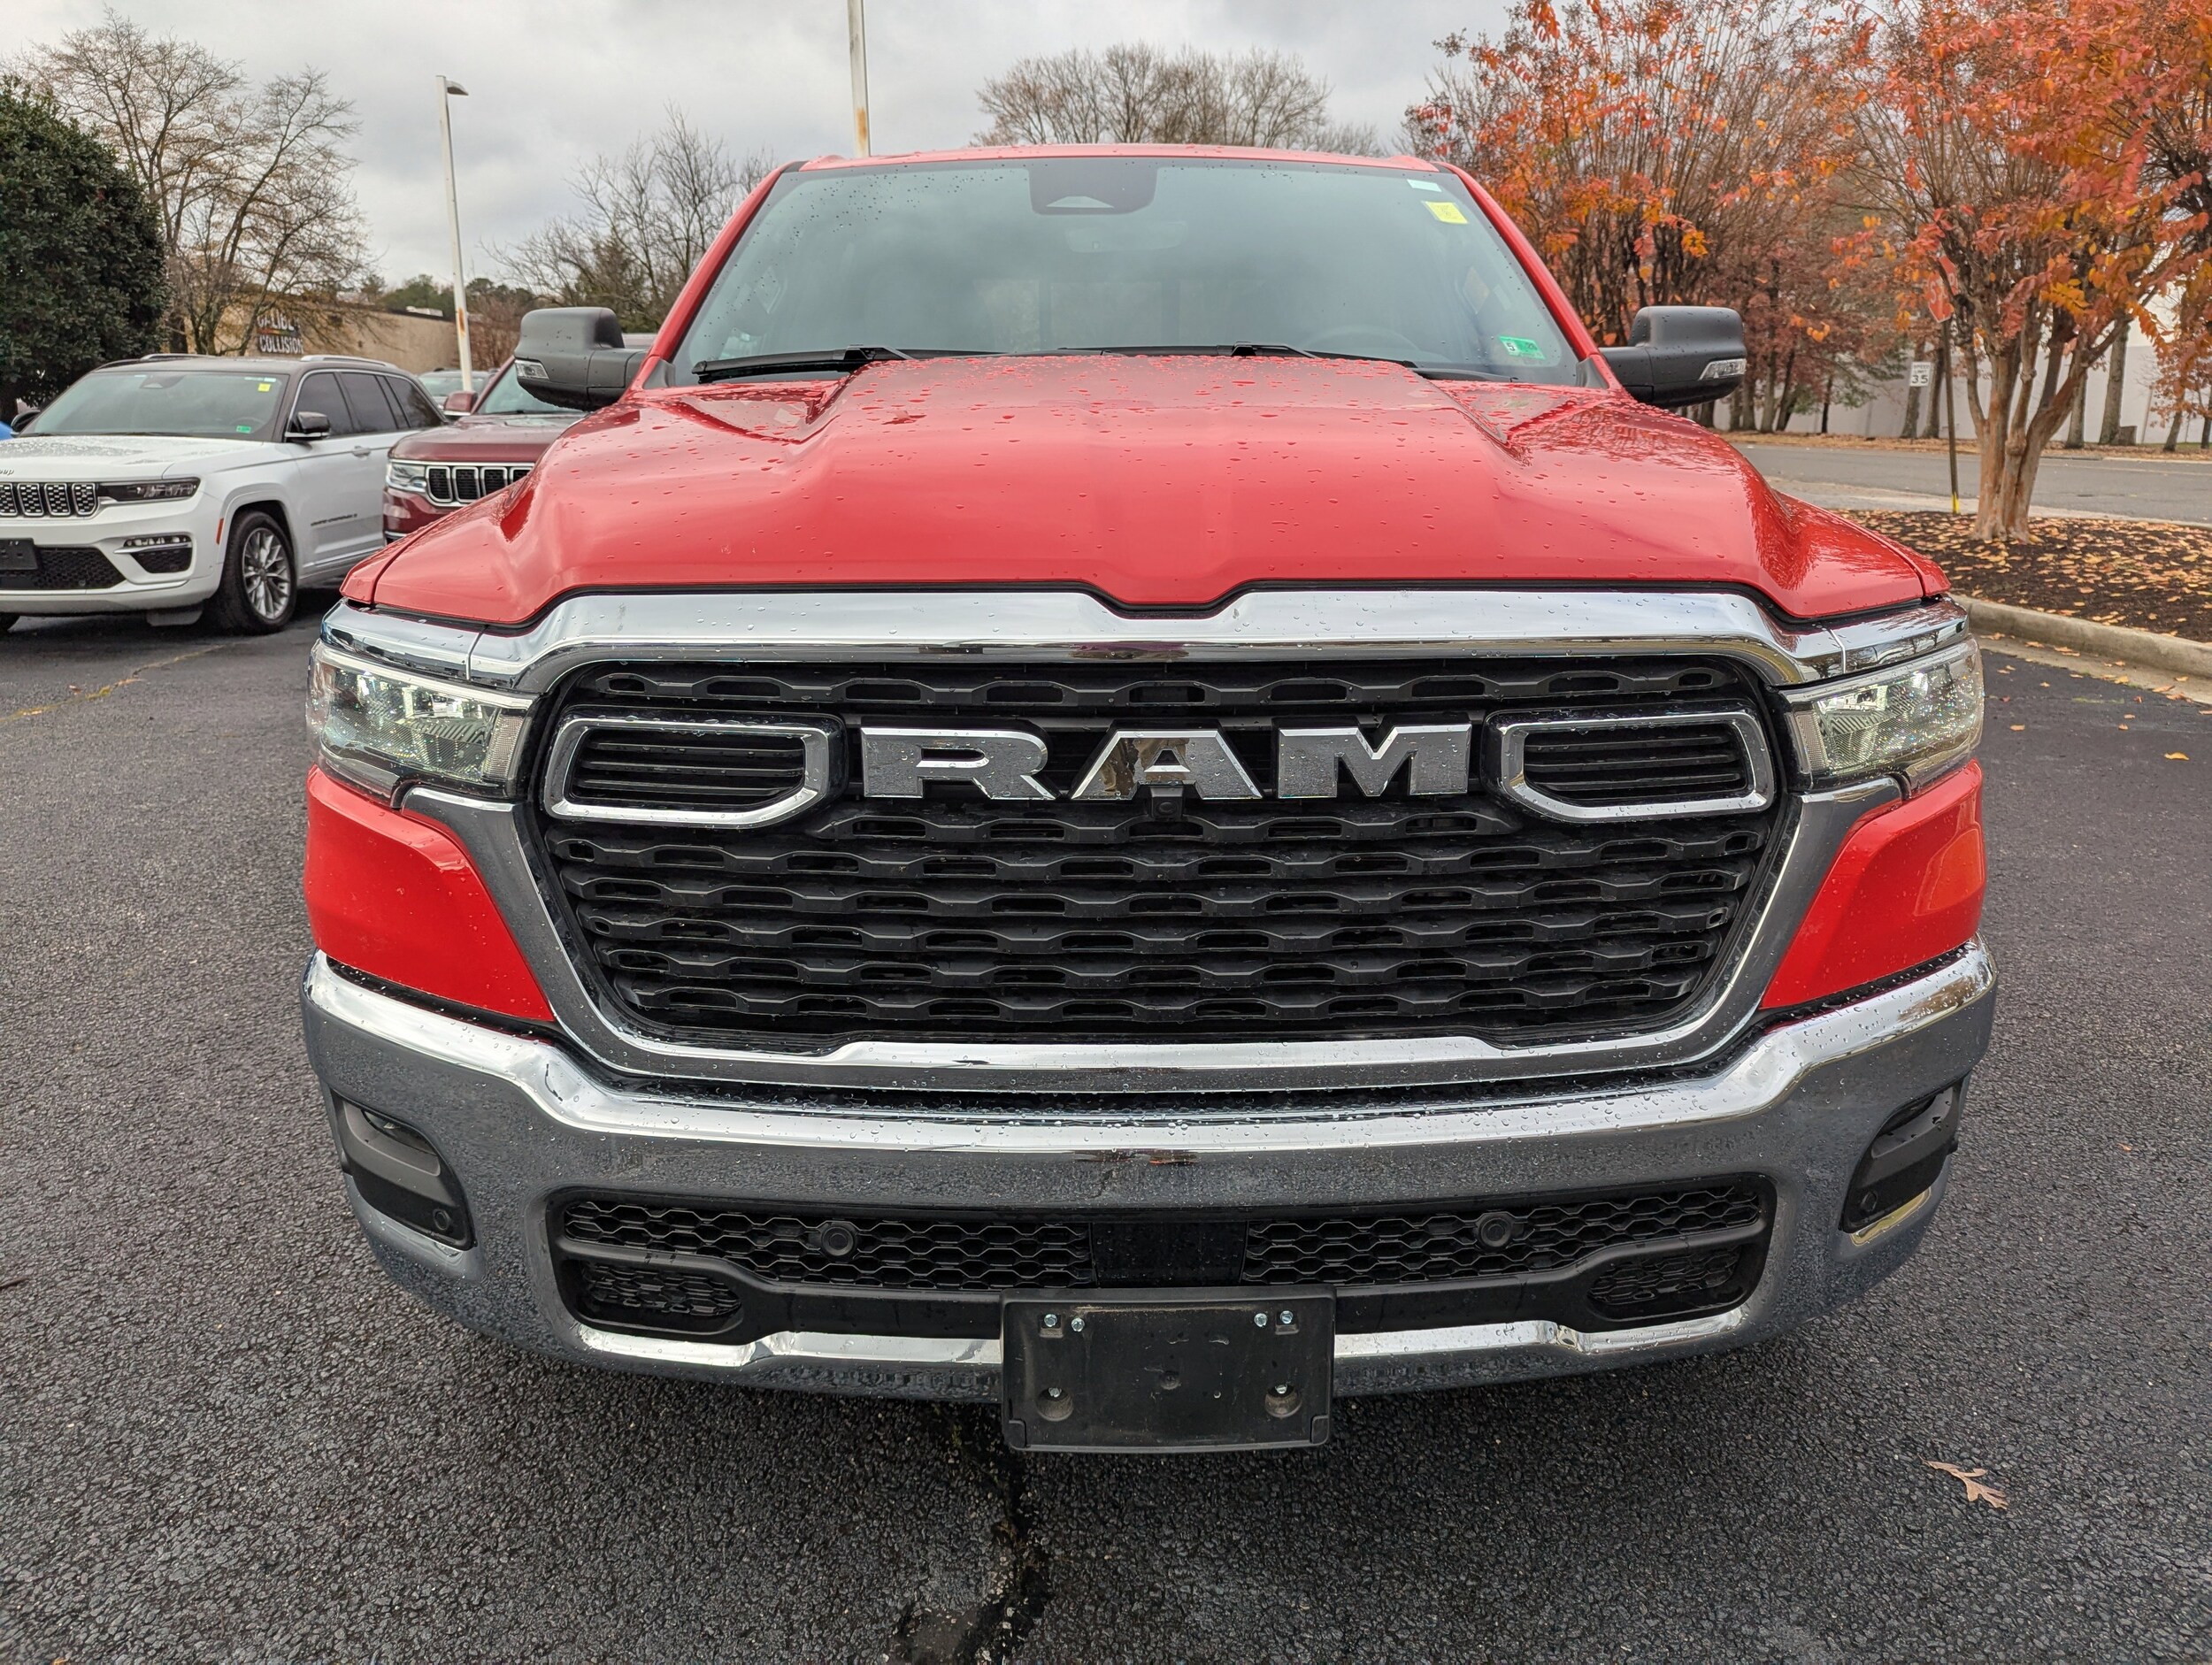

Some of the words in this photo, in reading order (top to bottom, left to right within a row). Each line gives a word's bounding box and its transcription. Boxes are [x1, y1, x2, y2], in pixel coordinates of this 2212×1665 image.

[1930, 272, 1955, 304] STP
[259, 334, 304, 354] COLLISION
[1911, 374, 1929, 384] 35
[862, 723, 1471, 801] RAM
